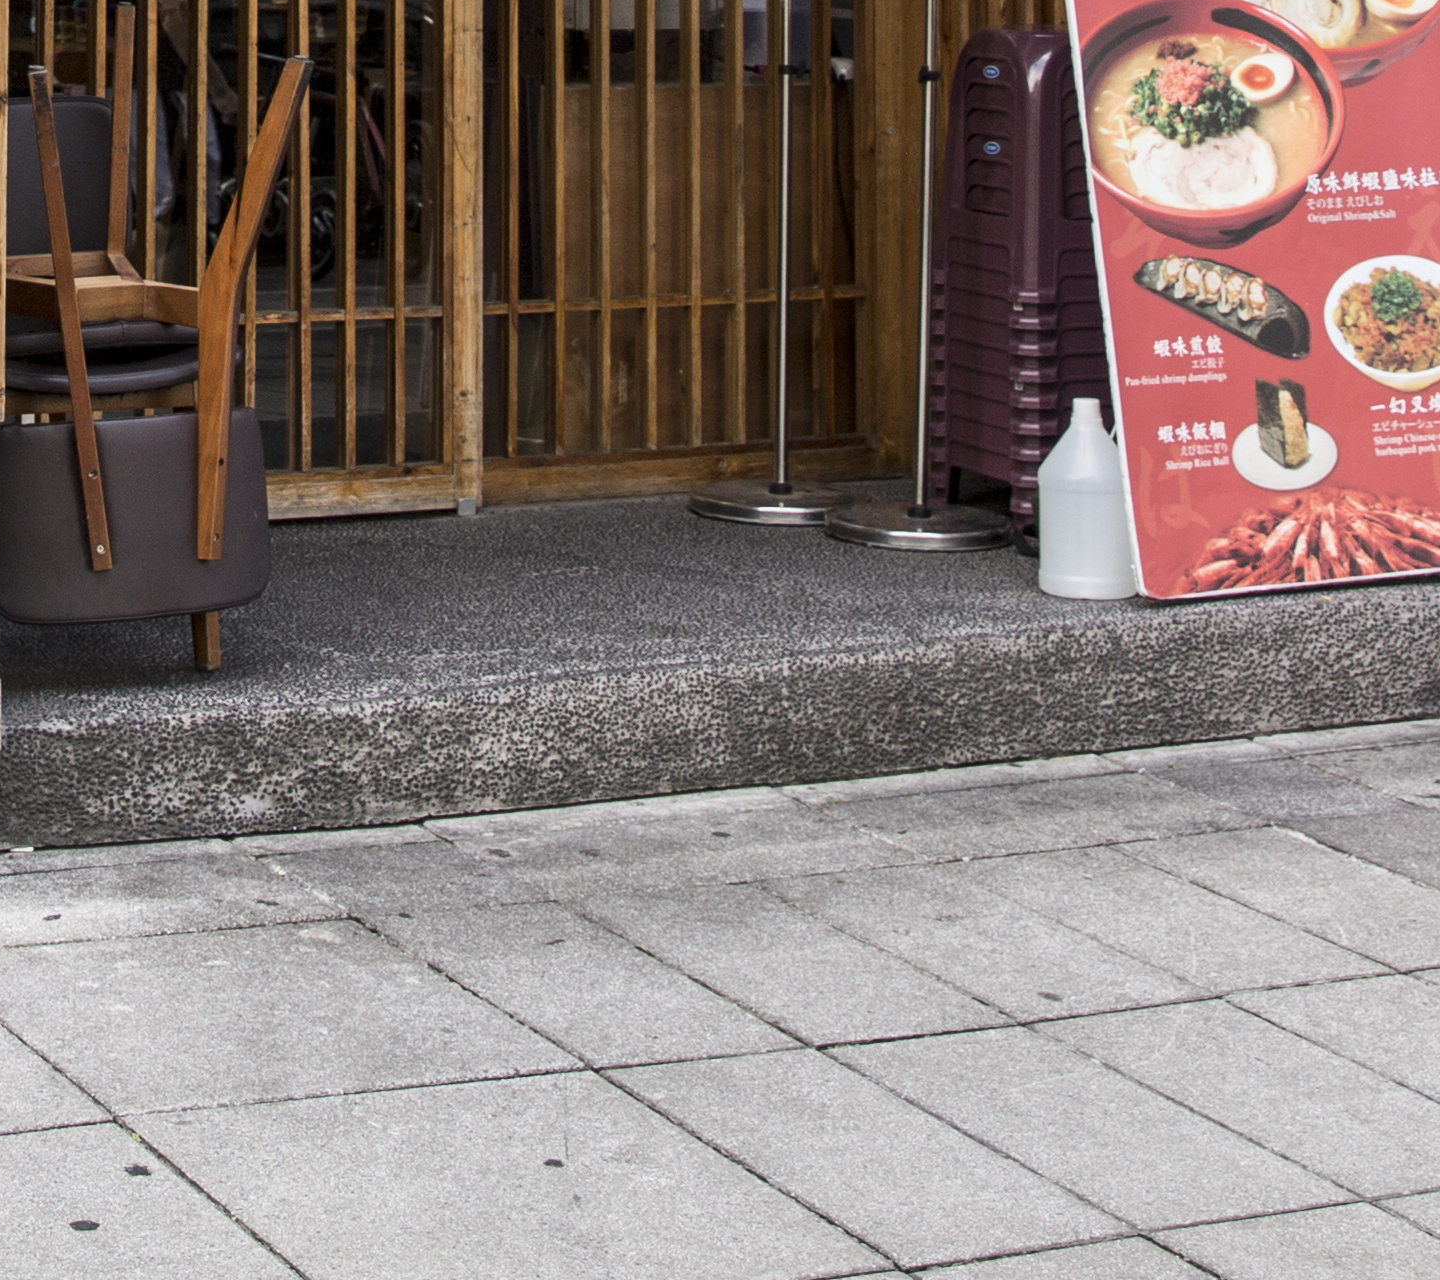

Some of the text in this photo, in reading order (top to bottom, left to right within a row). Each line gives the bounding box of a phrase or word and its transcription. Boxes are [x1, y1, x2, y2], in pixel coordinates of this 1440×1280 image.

[1307, 212, 1342, 225] Original
[1124, 372, 1227, 386] Pan-fried shrimp dumplings
[1418, 443, 1437, 455] pork
[1165, 455, 1230, 471] Shrimp Rice Ball
